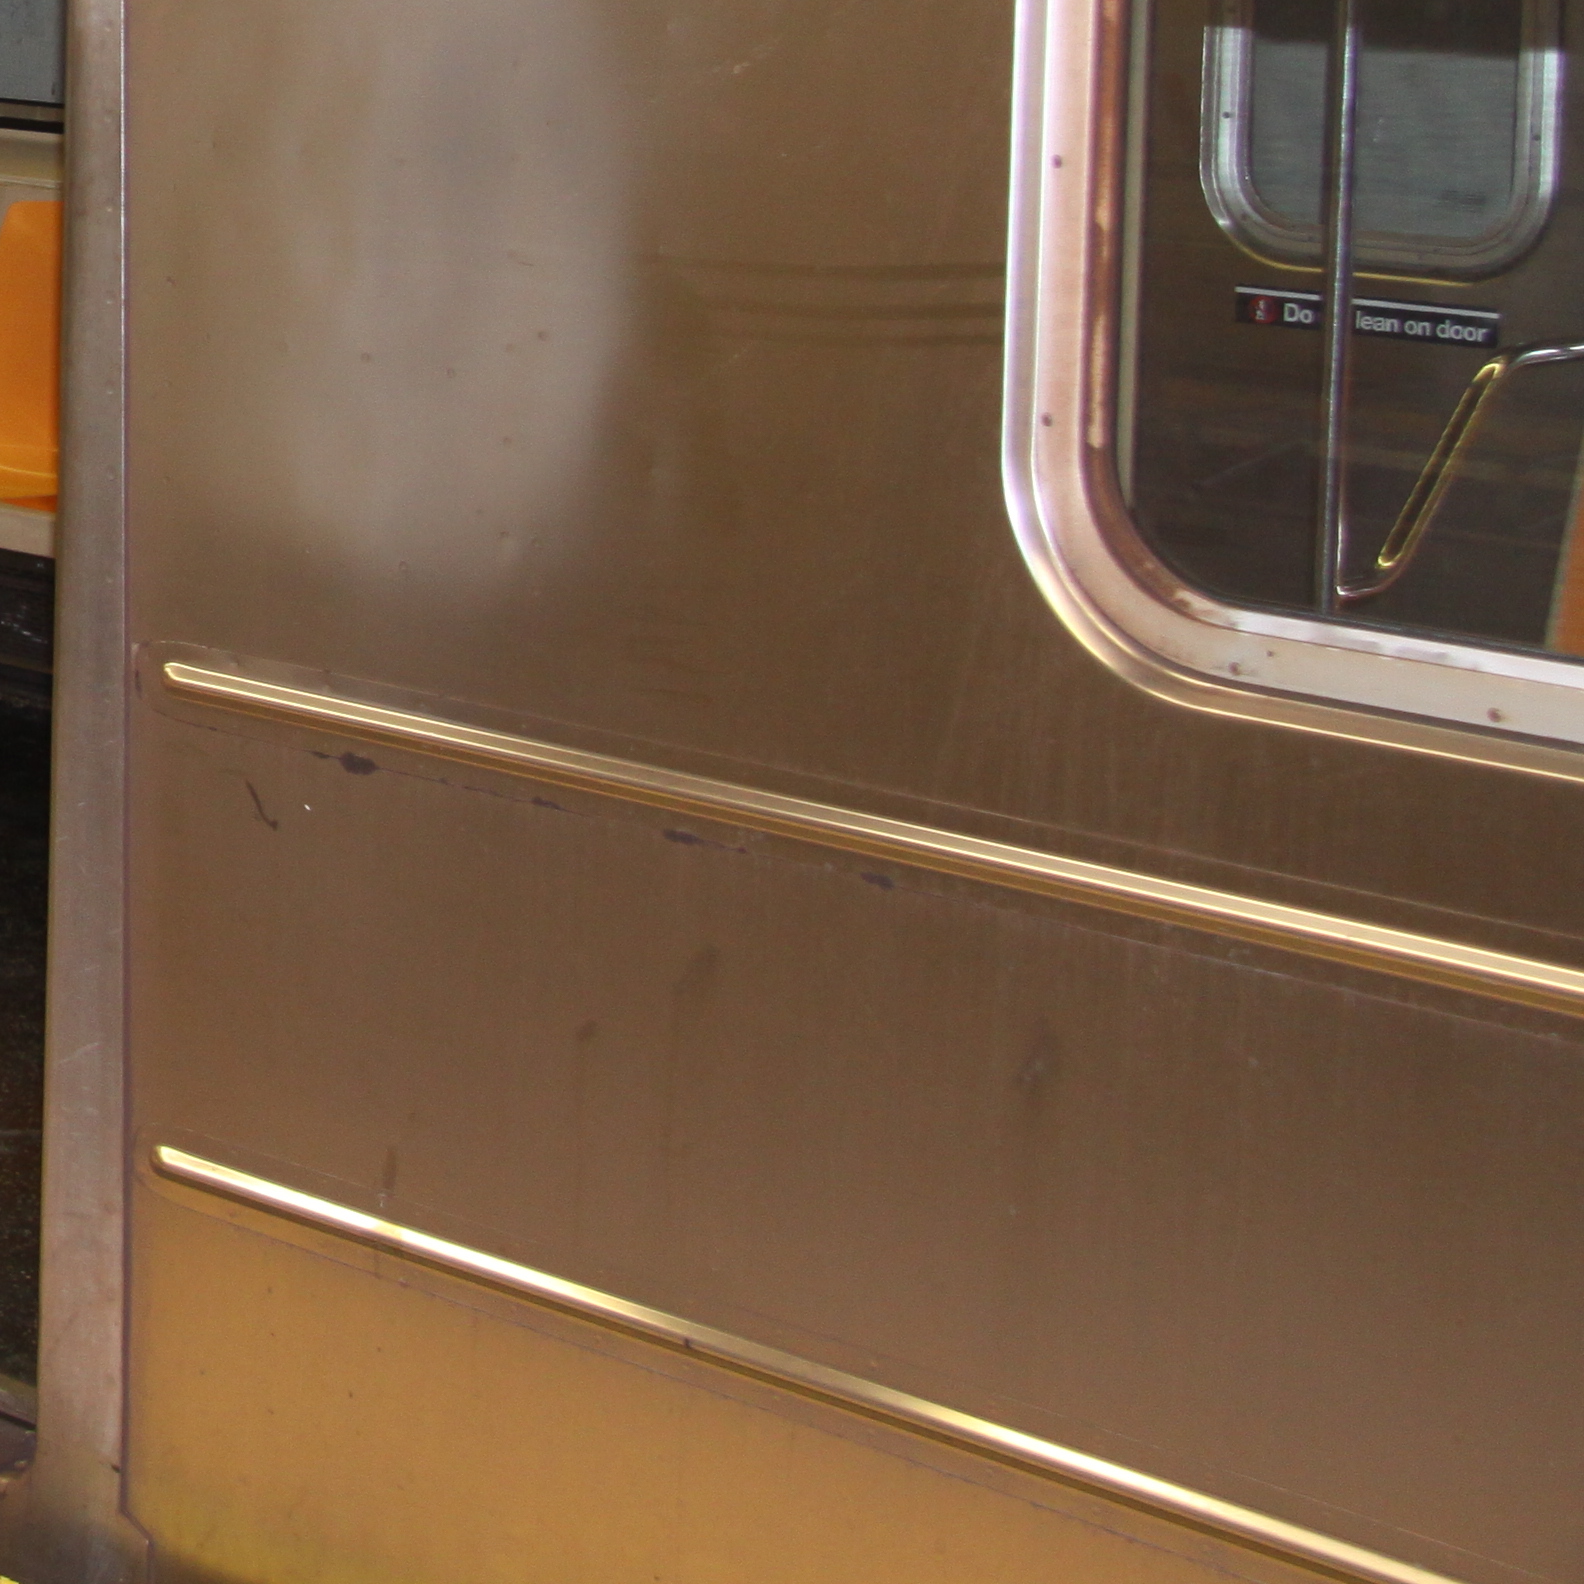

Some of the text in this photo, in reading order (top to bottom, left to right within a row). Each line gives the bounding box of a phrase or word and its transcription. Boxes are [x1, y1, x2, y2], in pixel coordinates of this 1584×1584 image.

[1283, 302, 1488, 343] Do lean on door
